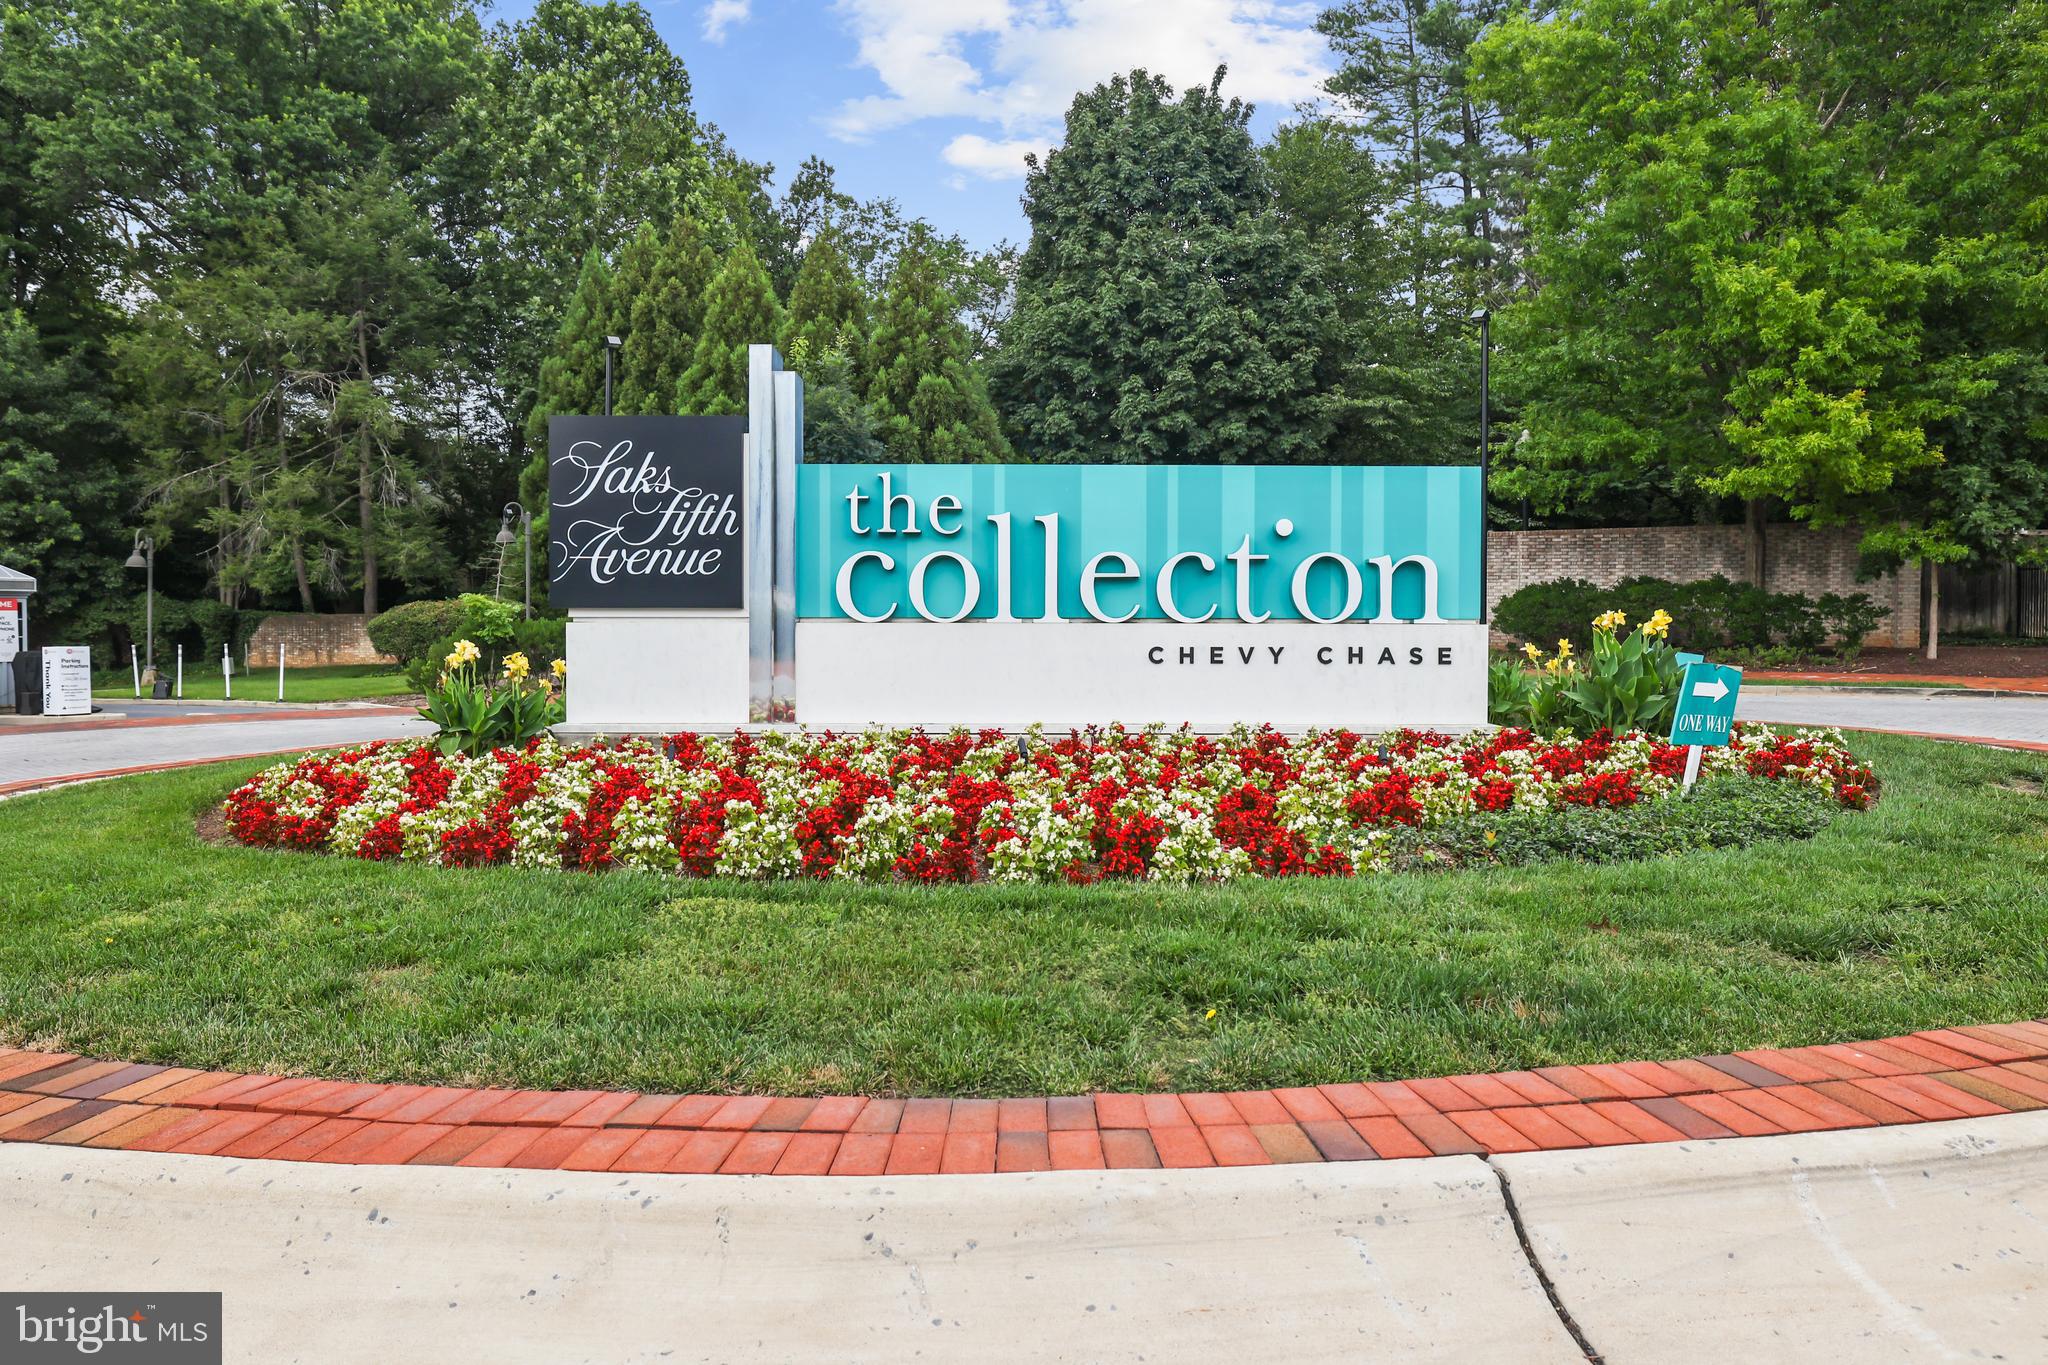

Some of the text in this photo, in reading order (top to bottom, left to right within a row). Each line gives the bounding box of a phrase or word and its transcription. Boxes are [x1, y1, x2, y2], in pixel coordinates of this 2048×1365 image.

[553, 440, 672, 507] Saks
[845, 471, 964, 536] the
[553, 520, 721, 584] Avenue
[1147, 646, 1454, 666] CHEVY CHASE
[1679, 713, 1730, 733] ONE WAY
